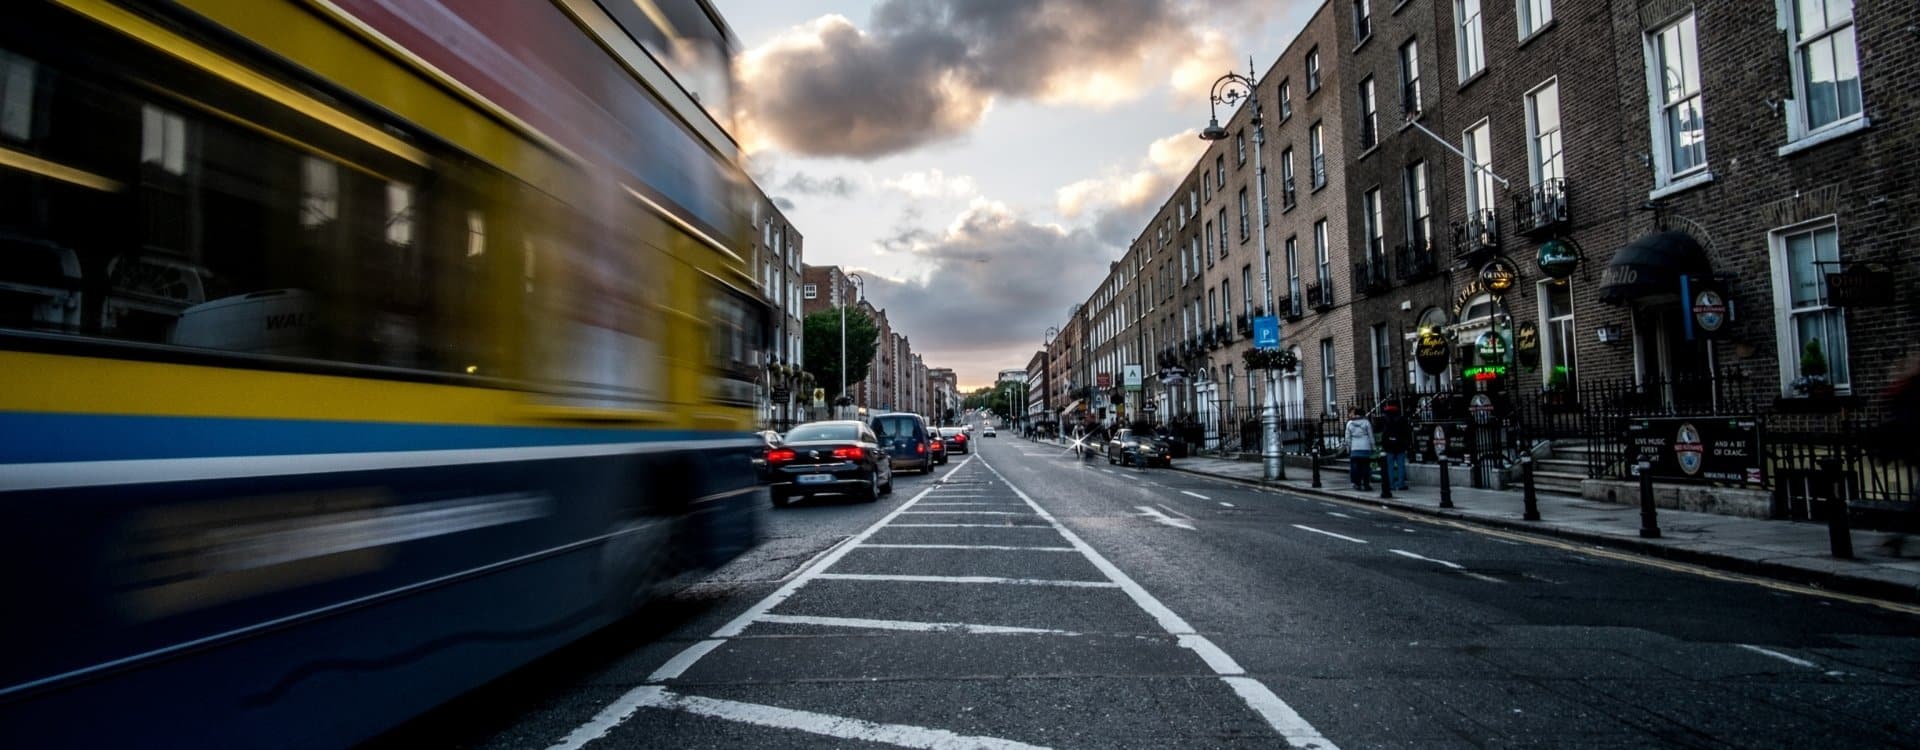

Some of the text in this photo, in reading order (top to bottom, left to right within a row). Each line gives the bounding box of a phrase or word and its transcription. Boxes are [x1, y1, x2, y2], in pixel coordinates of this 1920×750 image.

[1263, 329, 1270, 339] P
[1714, 440, 1746, 448] AND A BIT
[1641, 446, 1658, 454] EVERY
[1713, 448, 1722, 456] OF
